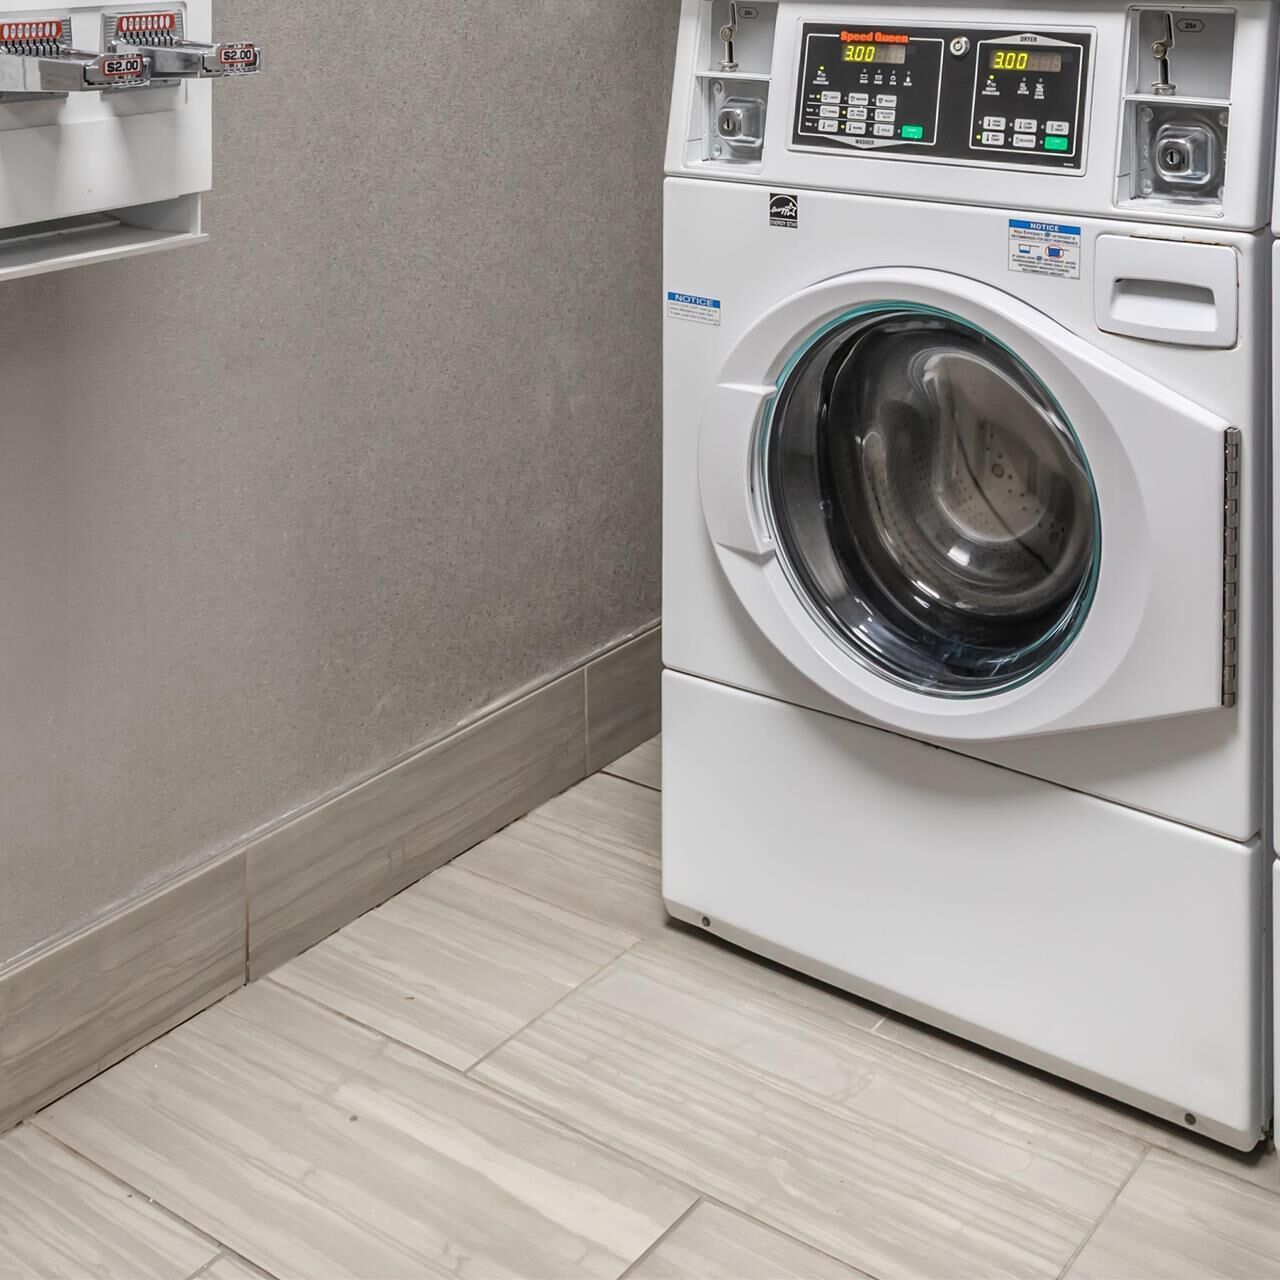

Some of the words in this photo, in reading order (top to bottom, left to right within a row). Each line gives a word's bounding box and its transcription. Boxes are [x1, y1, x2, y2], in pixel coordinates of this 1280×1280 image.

[840, 31, 873, 42] Speed
[875, 32, 909, 43] Queen
[1030, 222, 1059, 231] NOTICE
[675, 294, 713, 307] NOTICE
